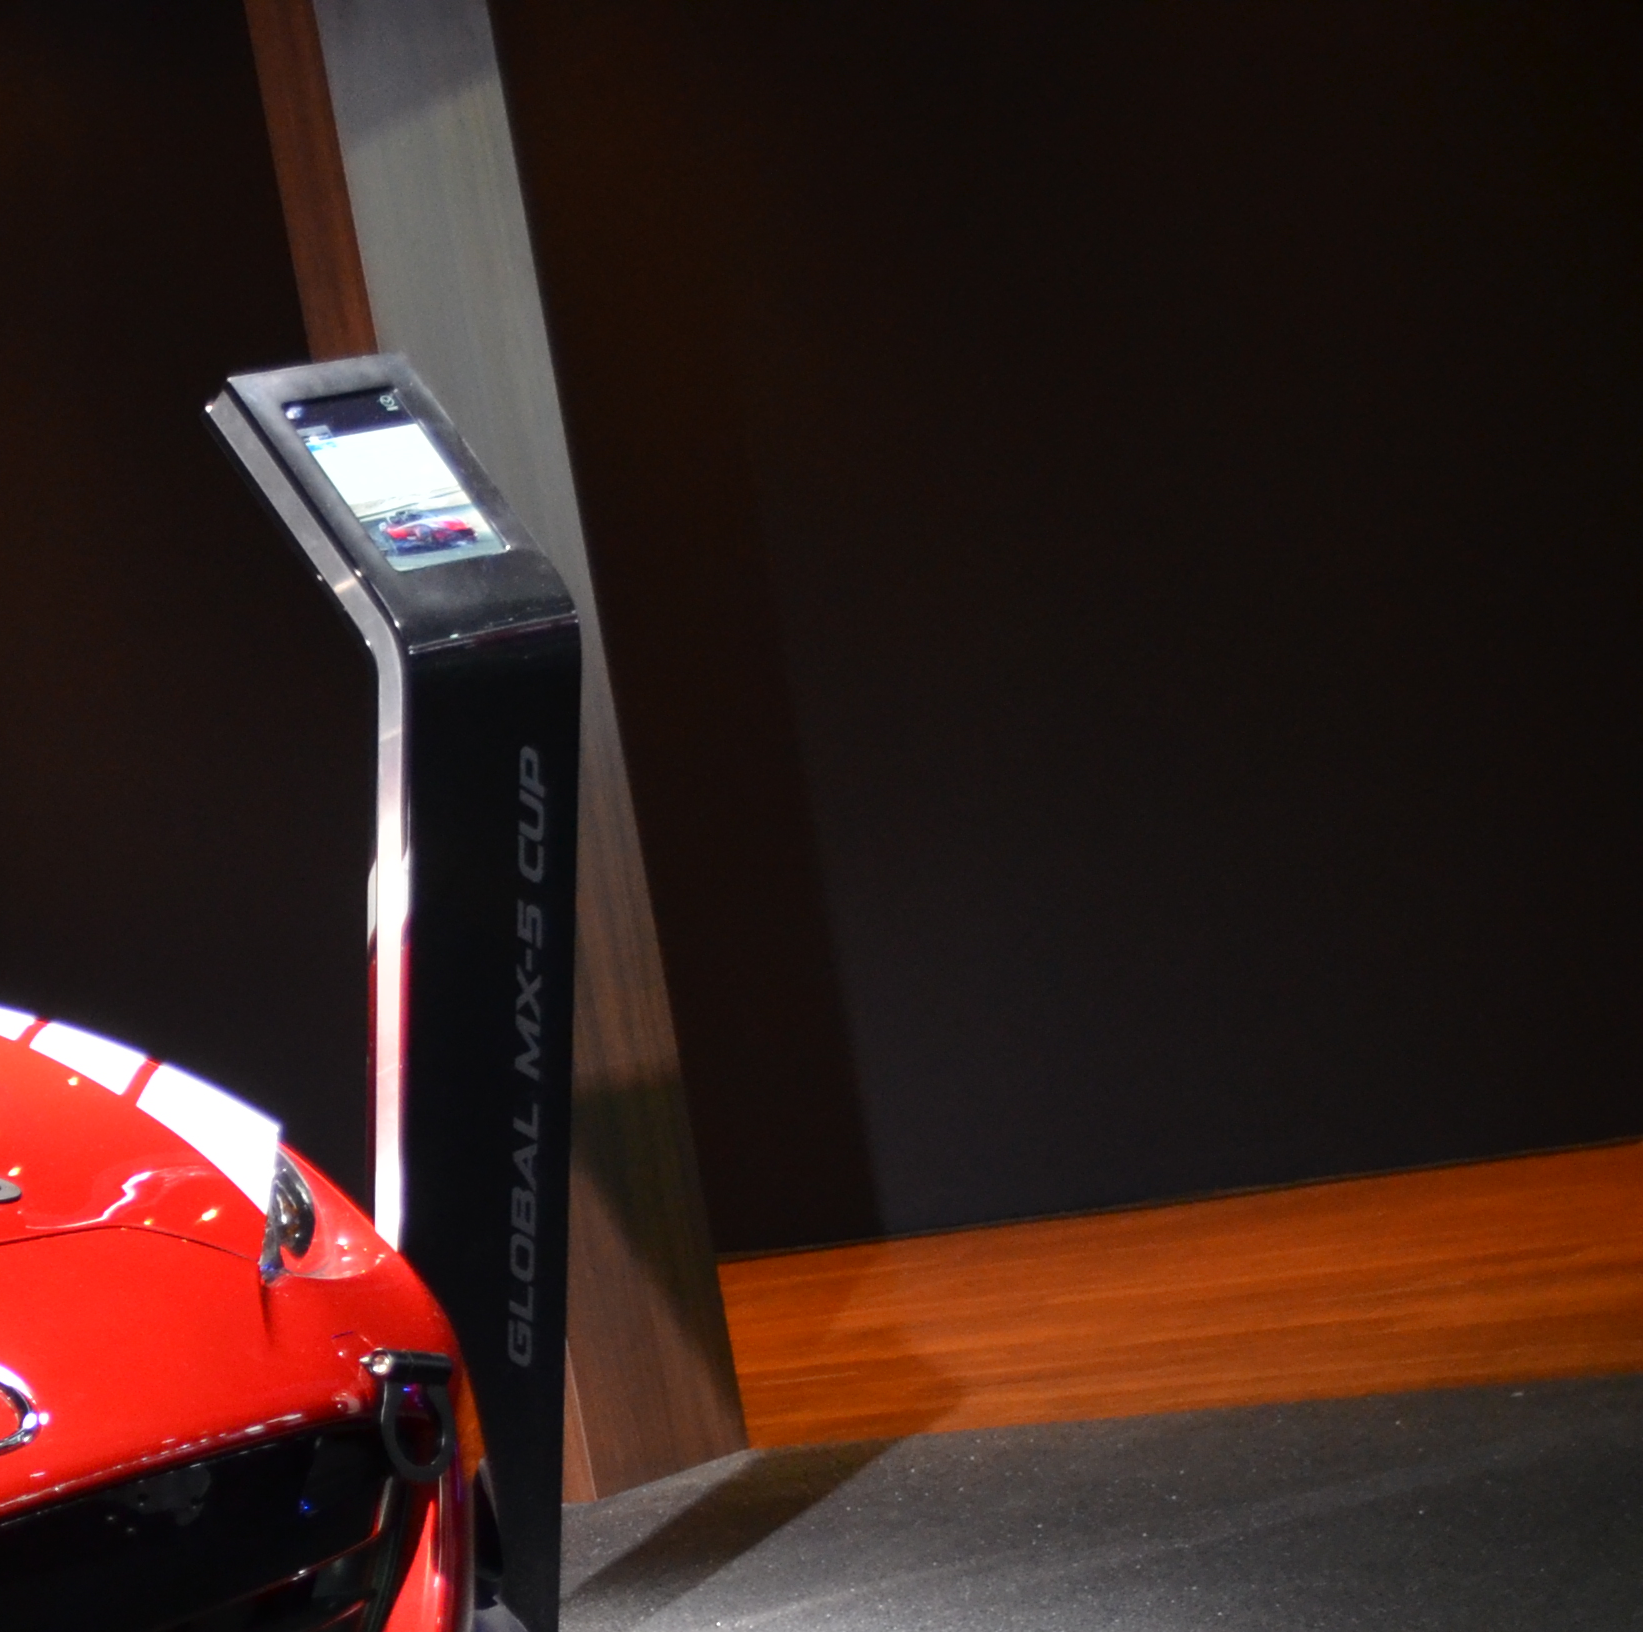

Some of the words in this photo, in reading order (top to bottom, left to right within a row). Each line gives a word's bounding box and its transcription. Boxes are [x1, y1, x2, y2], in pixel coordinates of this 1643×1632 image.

[517, 745, 549, 884] CUP
[514, 898, 542, 1084] MX-5
[506, 1102, 541, 1368] GLOBAL
